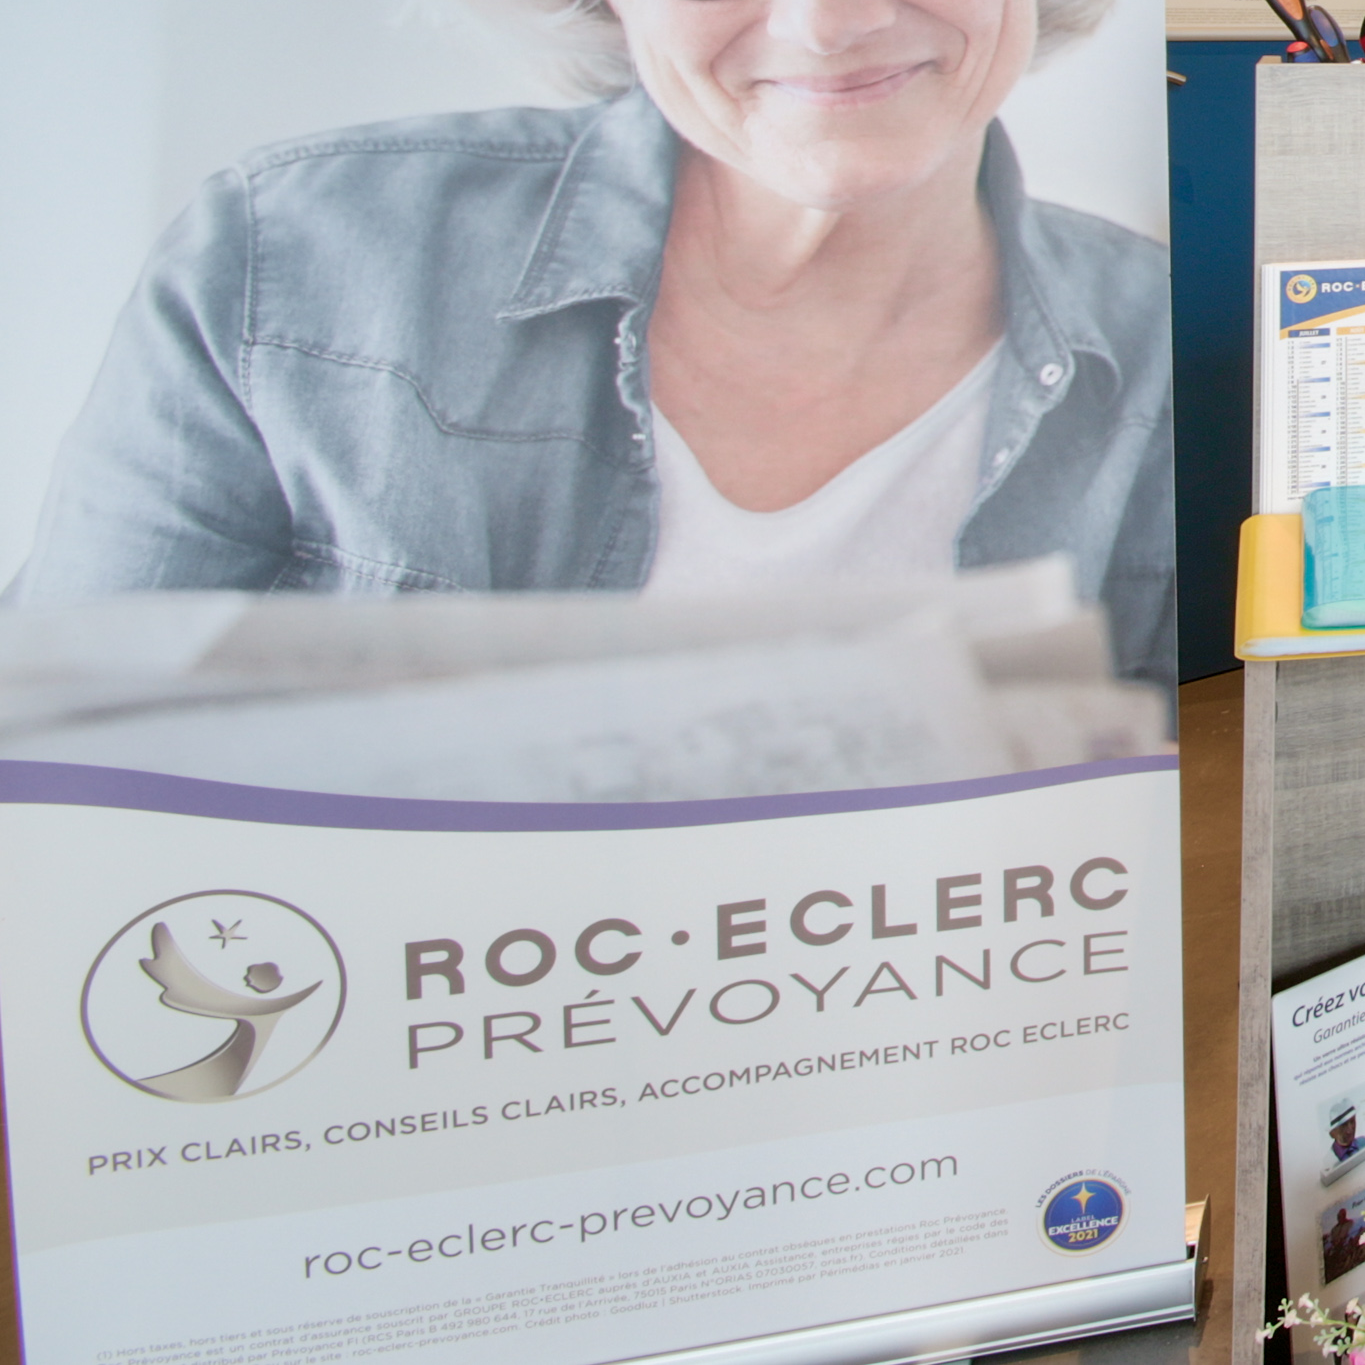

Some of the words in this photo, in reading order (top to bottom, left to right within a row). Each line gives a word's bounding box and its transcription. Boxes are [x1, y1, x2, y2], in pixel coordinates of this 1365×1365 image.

[408, 931, 1128, 1069] PRÉVOYANCE
[1292, 993, 1344, 1027] Créez
[1313, 1010, 1365, 1044] Garantie
[89, 1147, 166, 1175] PRIX
[181, 1131, 310, 1162] CLAIRS,
[324, 1106, 488, 1144] CONSEILS
[502, 1088, 625, 1120] CLAIRS,
[639, 1041, 938, 1101] ACCOMPAGNEMENT
[951, 1030, 1010, 1054] ROC
[1023, 1013, 1129, 1043] ECLERC
[1046, 1170, 1083, 1195] DOSSIERS
[305, 1156, 957, 1278] roc-eclerc-prevoyance.com
[1048, 1216, 1119, 1235] EXCELLENCE
[869, 1242, 927, 1259] Conditions
[930, 1234, 981, 1249] détaillées
[1068, 1229, 1098, 1242] 2021
[486, 1286, 536, 1302] Garantie
[610, 1300, 658, 1315] Goodluz
[900, 1252, 936, 1266] janvier
[454, 1303, 506, 1318] GROUPE
